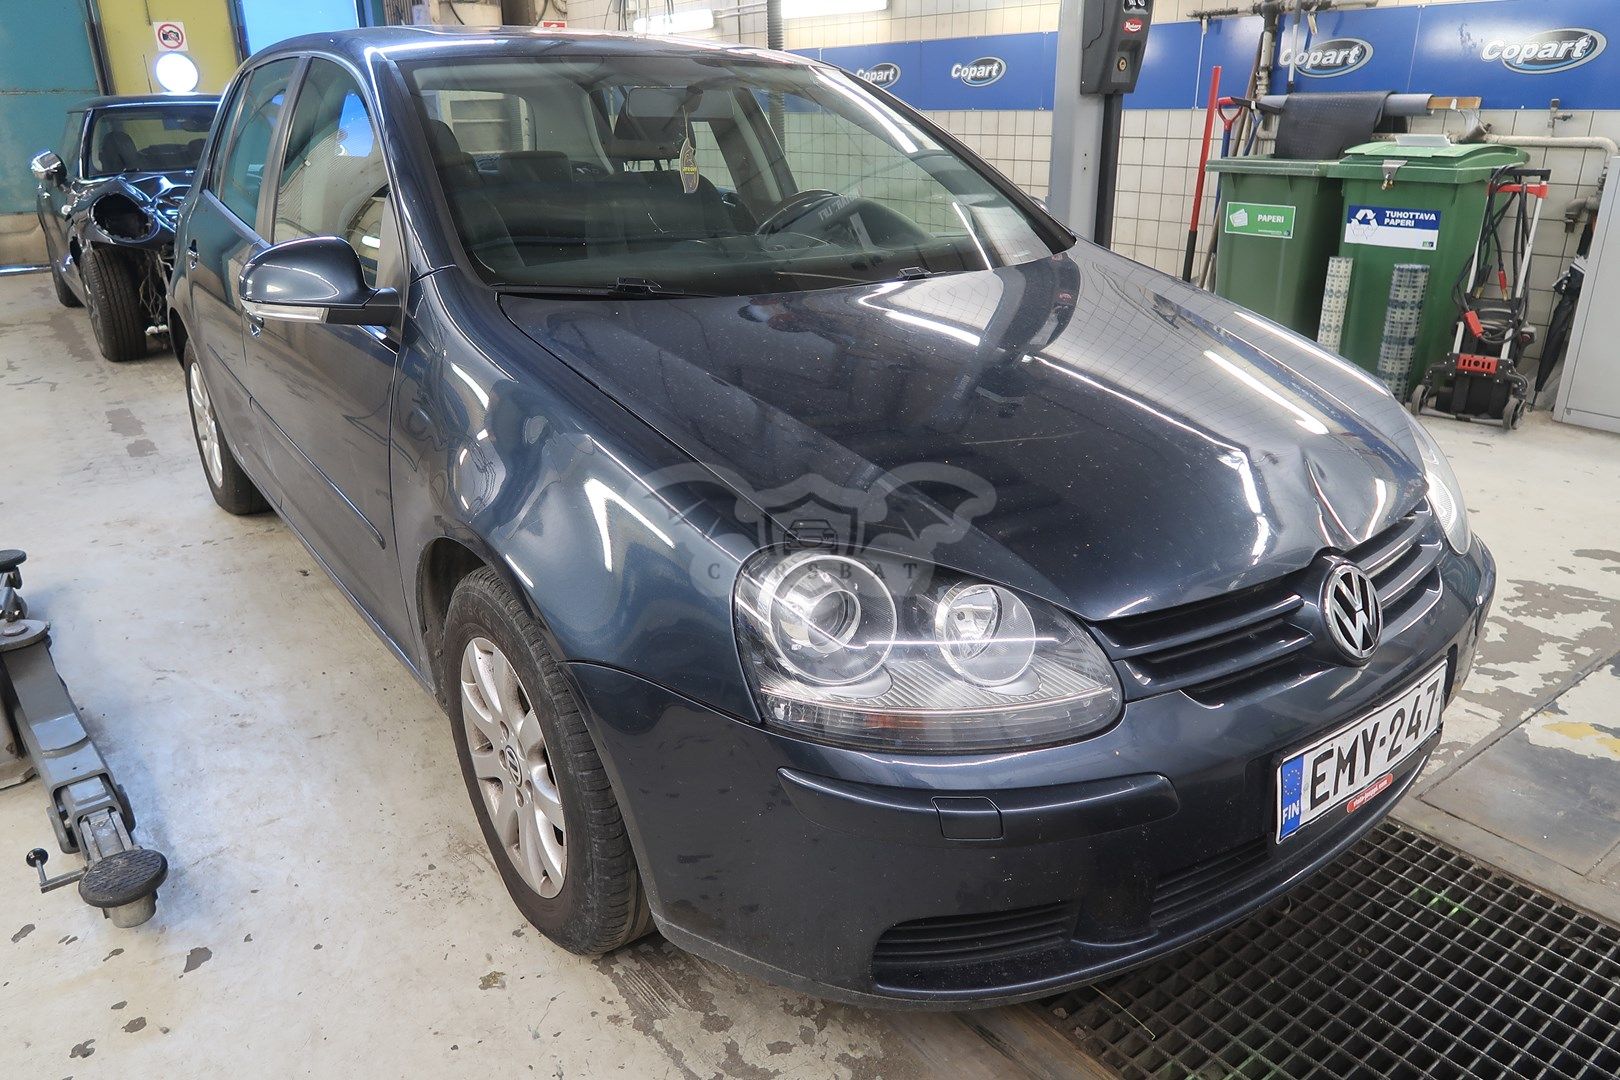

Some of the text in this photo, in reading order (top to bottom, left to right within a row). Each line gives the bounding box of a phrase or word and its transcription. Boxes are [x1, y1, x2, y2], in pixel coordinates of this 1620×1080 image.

[1278, 43, 1364, 69] Copart
[1480, 33, 1594, 68] Copart
[856, 69, 896, 83] Copart
[951, 62, 1000, 81] Copart
[1257, 214, 1285, 223] PAPERI
[1383, 218, 1415, 227] PAPERI
[1385, 210, 1437, 221] TUHOTTAVA
[1309, 678, 1440, 811] EMY-247
[1282, 800, 1299, 825] FIN
